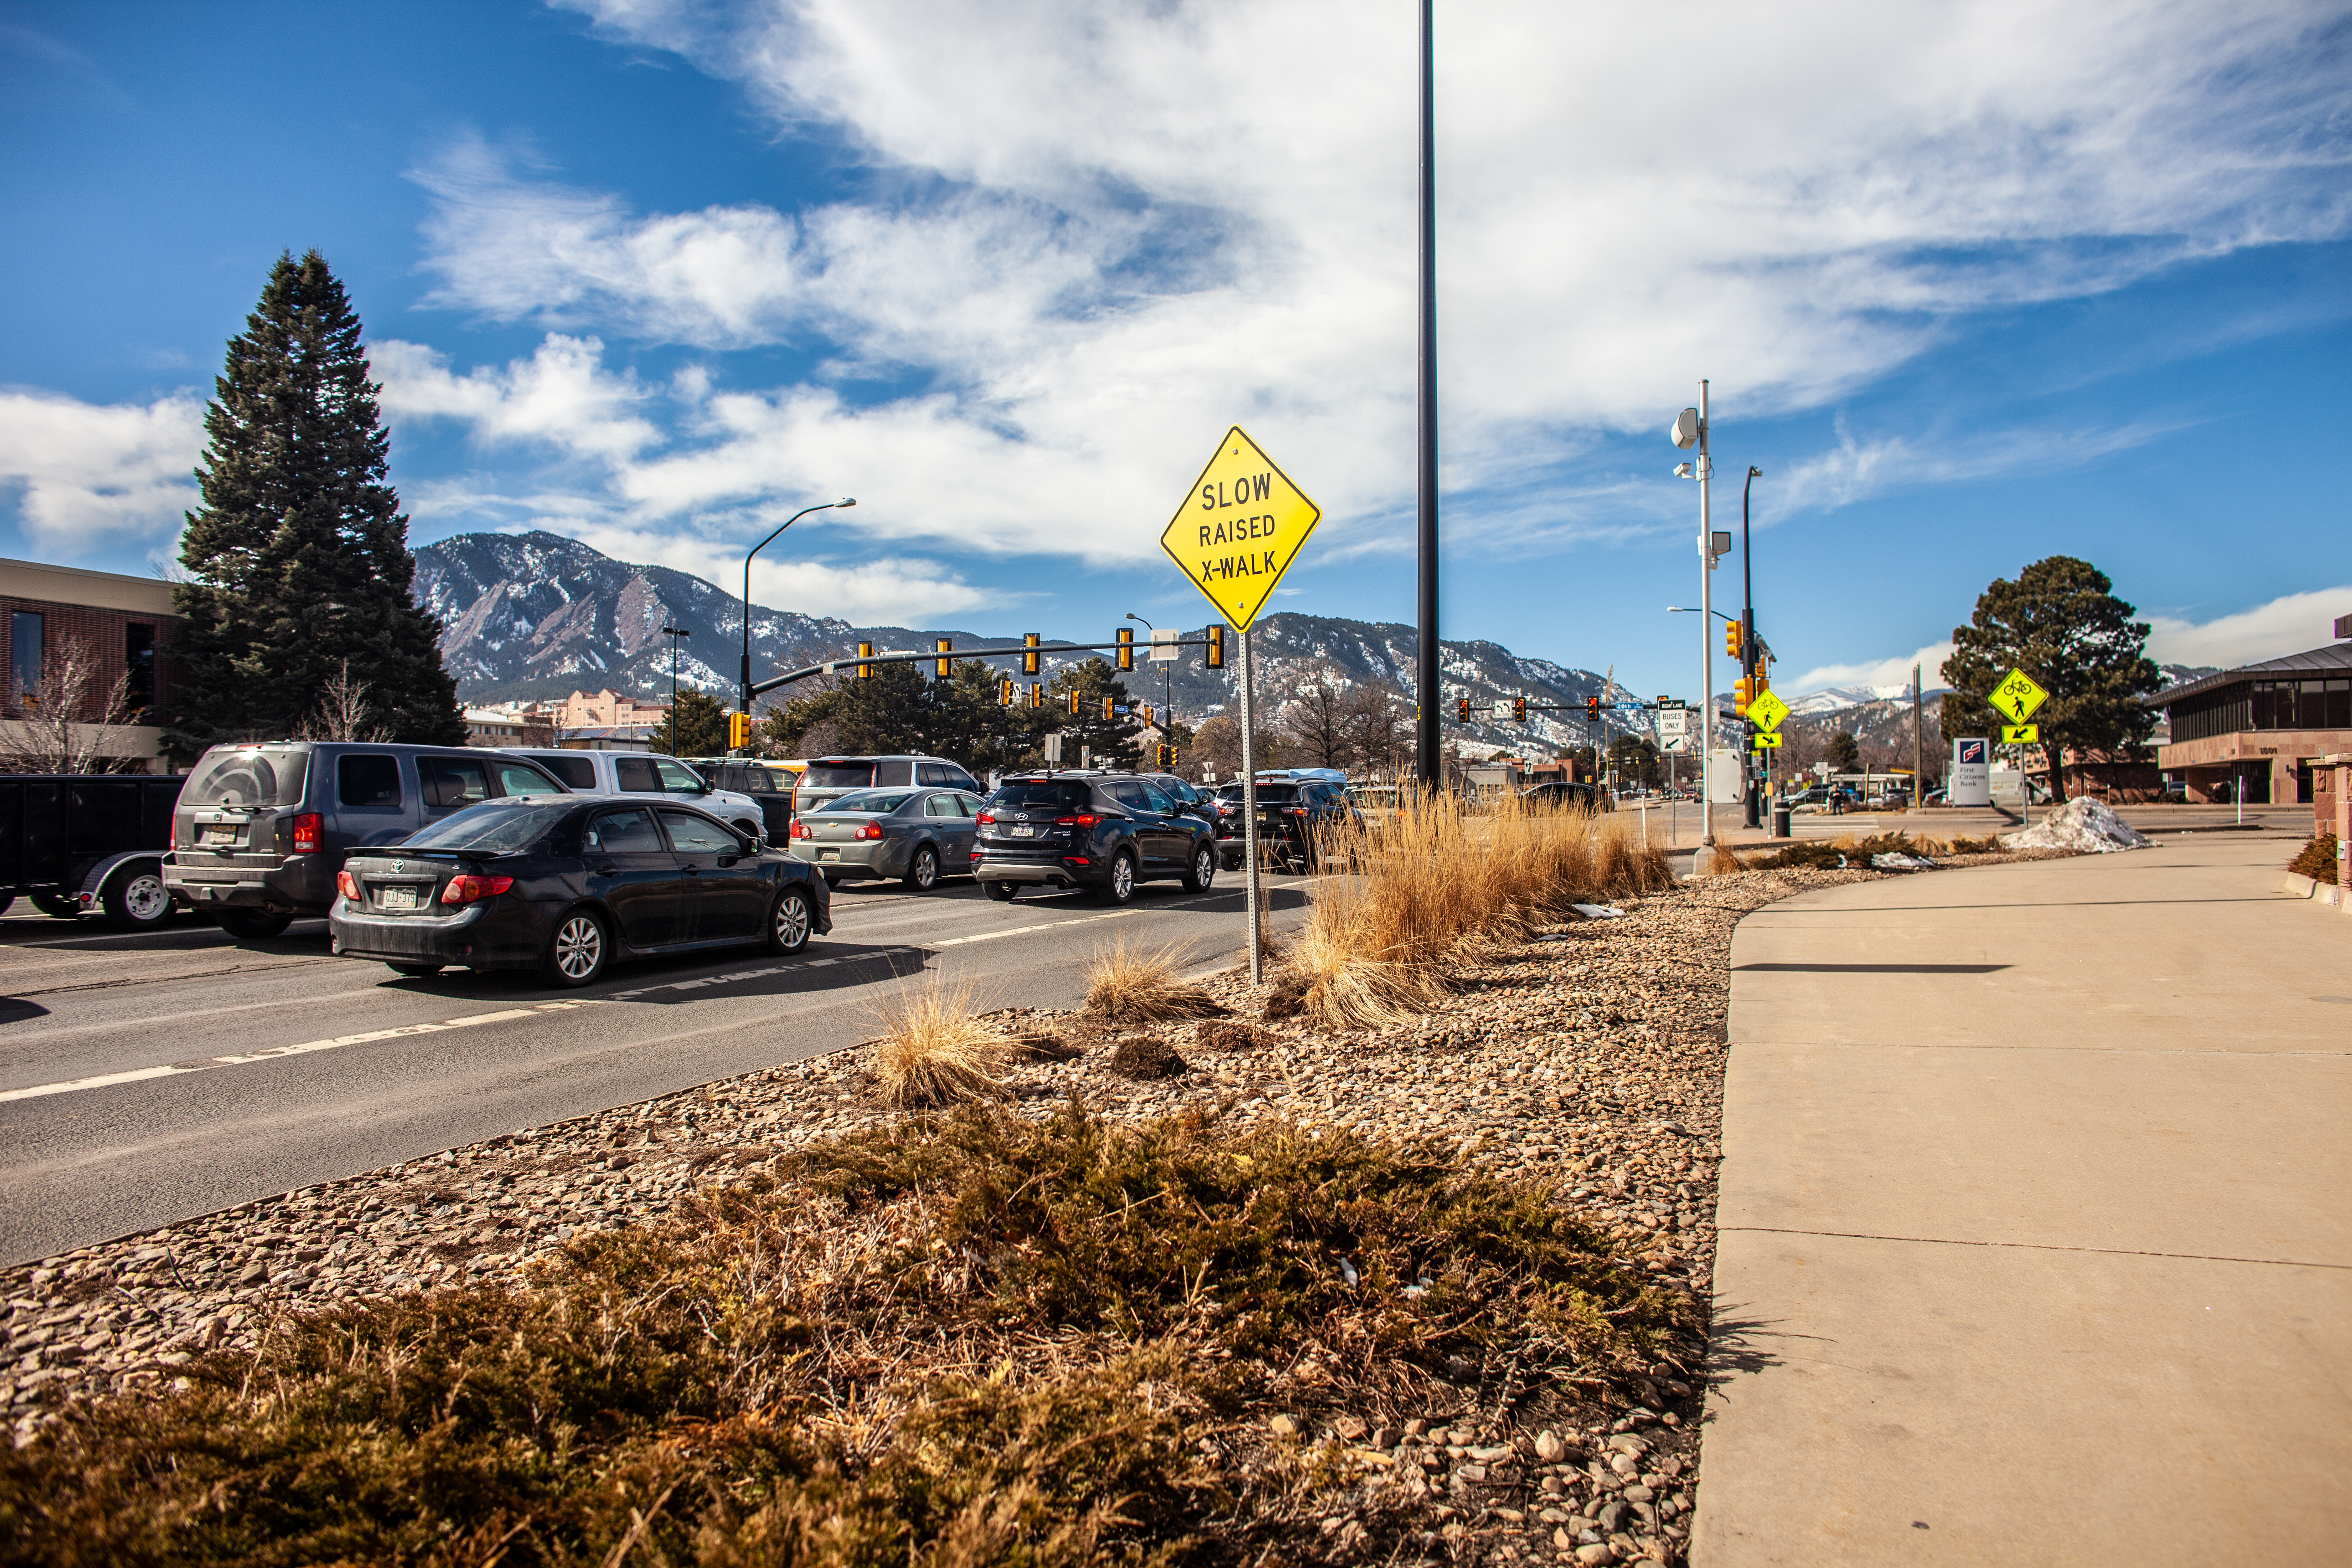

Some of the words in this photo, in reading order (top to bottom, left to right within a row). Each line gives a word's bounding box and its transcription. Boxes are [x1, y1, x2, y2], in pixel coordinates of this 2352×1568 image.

[1202, 472, 1271, 511] SLOW
[1199, 514, 1275, 547] RAISED
[1202, 550, 1277, 582] X-WALK
